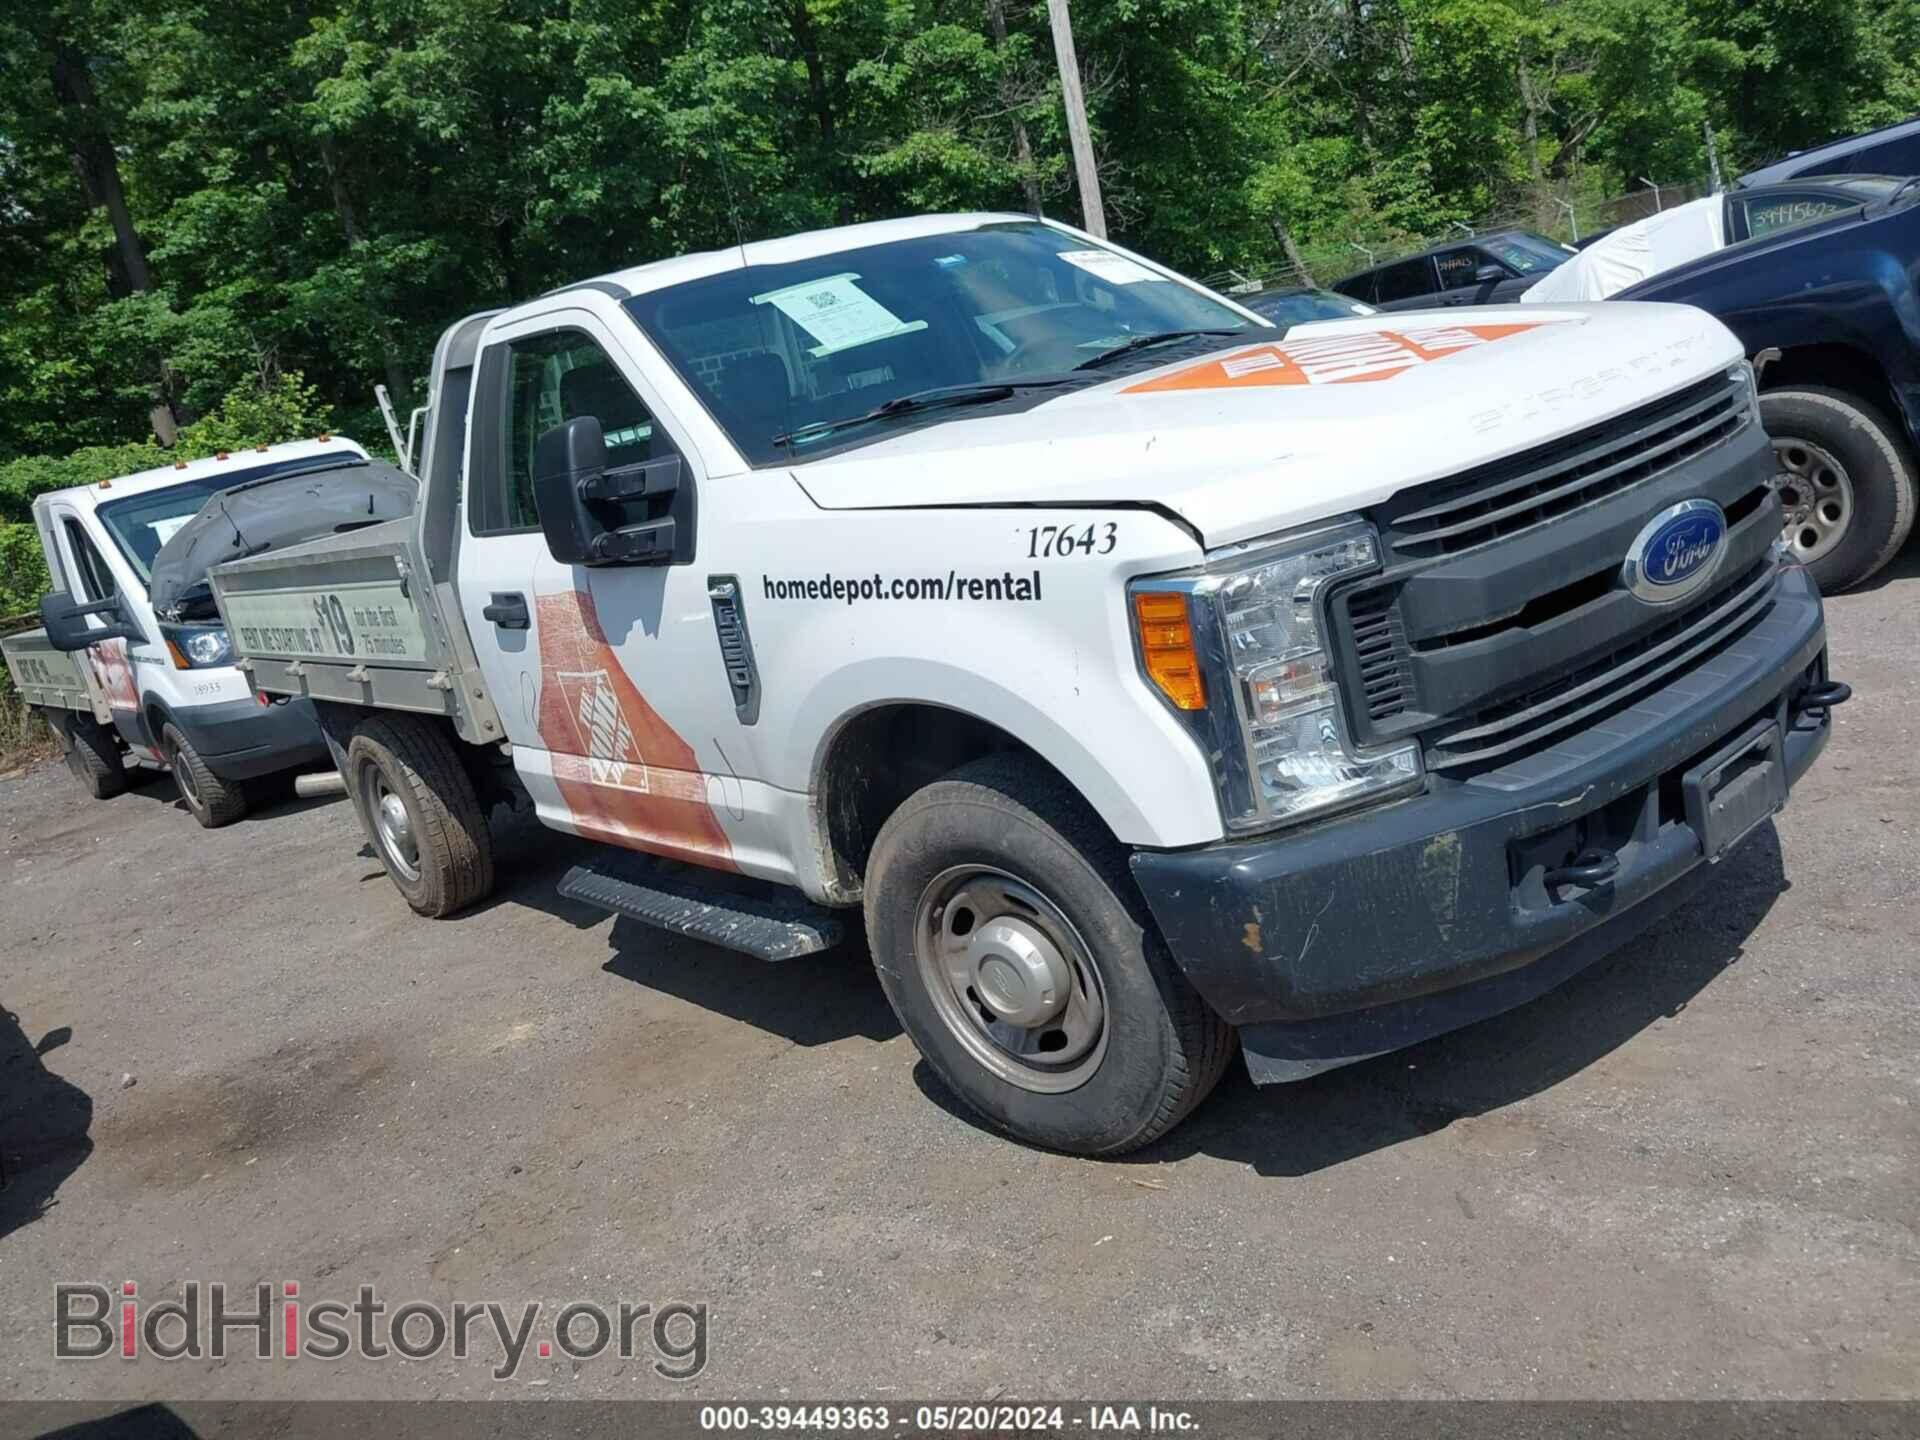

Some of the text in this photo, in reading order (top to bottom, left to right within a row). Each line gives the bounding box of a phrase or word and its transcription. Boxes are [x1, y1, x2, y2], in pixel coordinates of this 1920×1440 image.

[1027, 522, 1118, 558] 17643
[1663, 523, 1711, 577] Ford
[763, 570, 1041, 605] homedepot.com/rental
